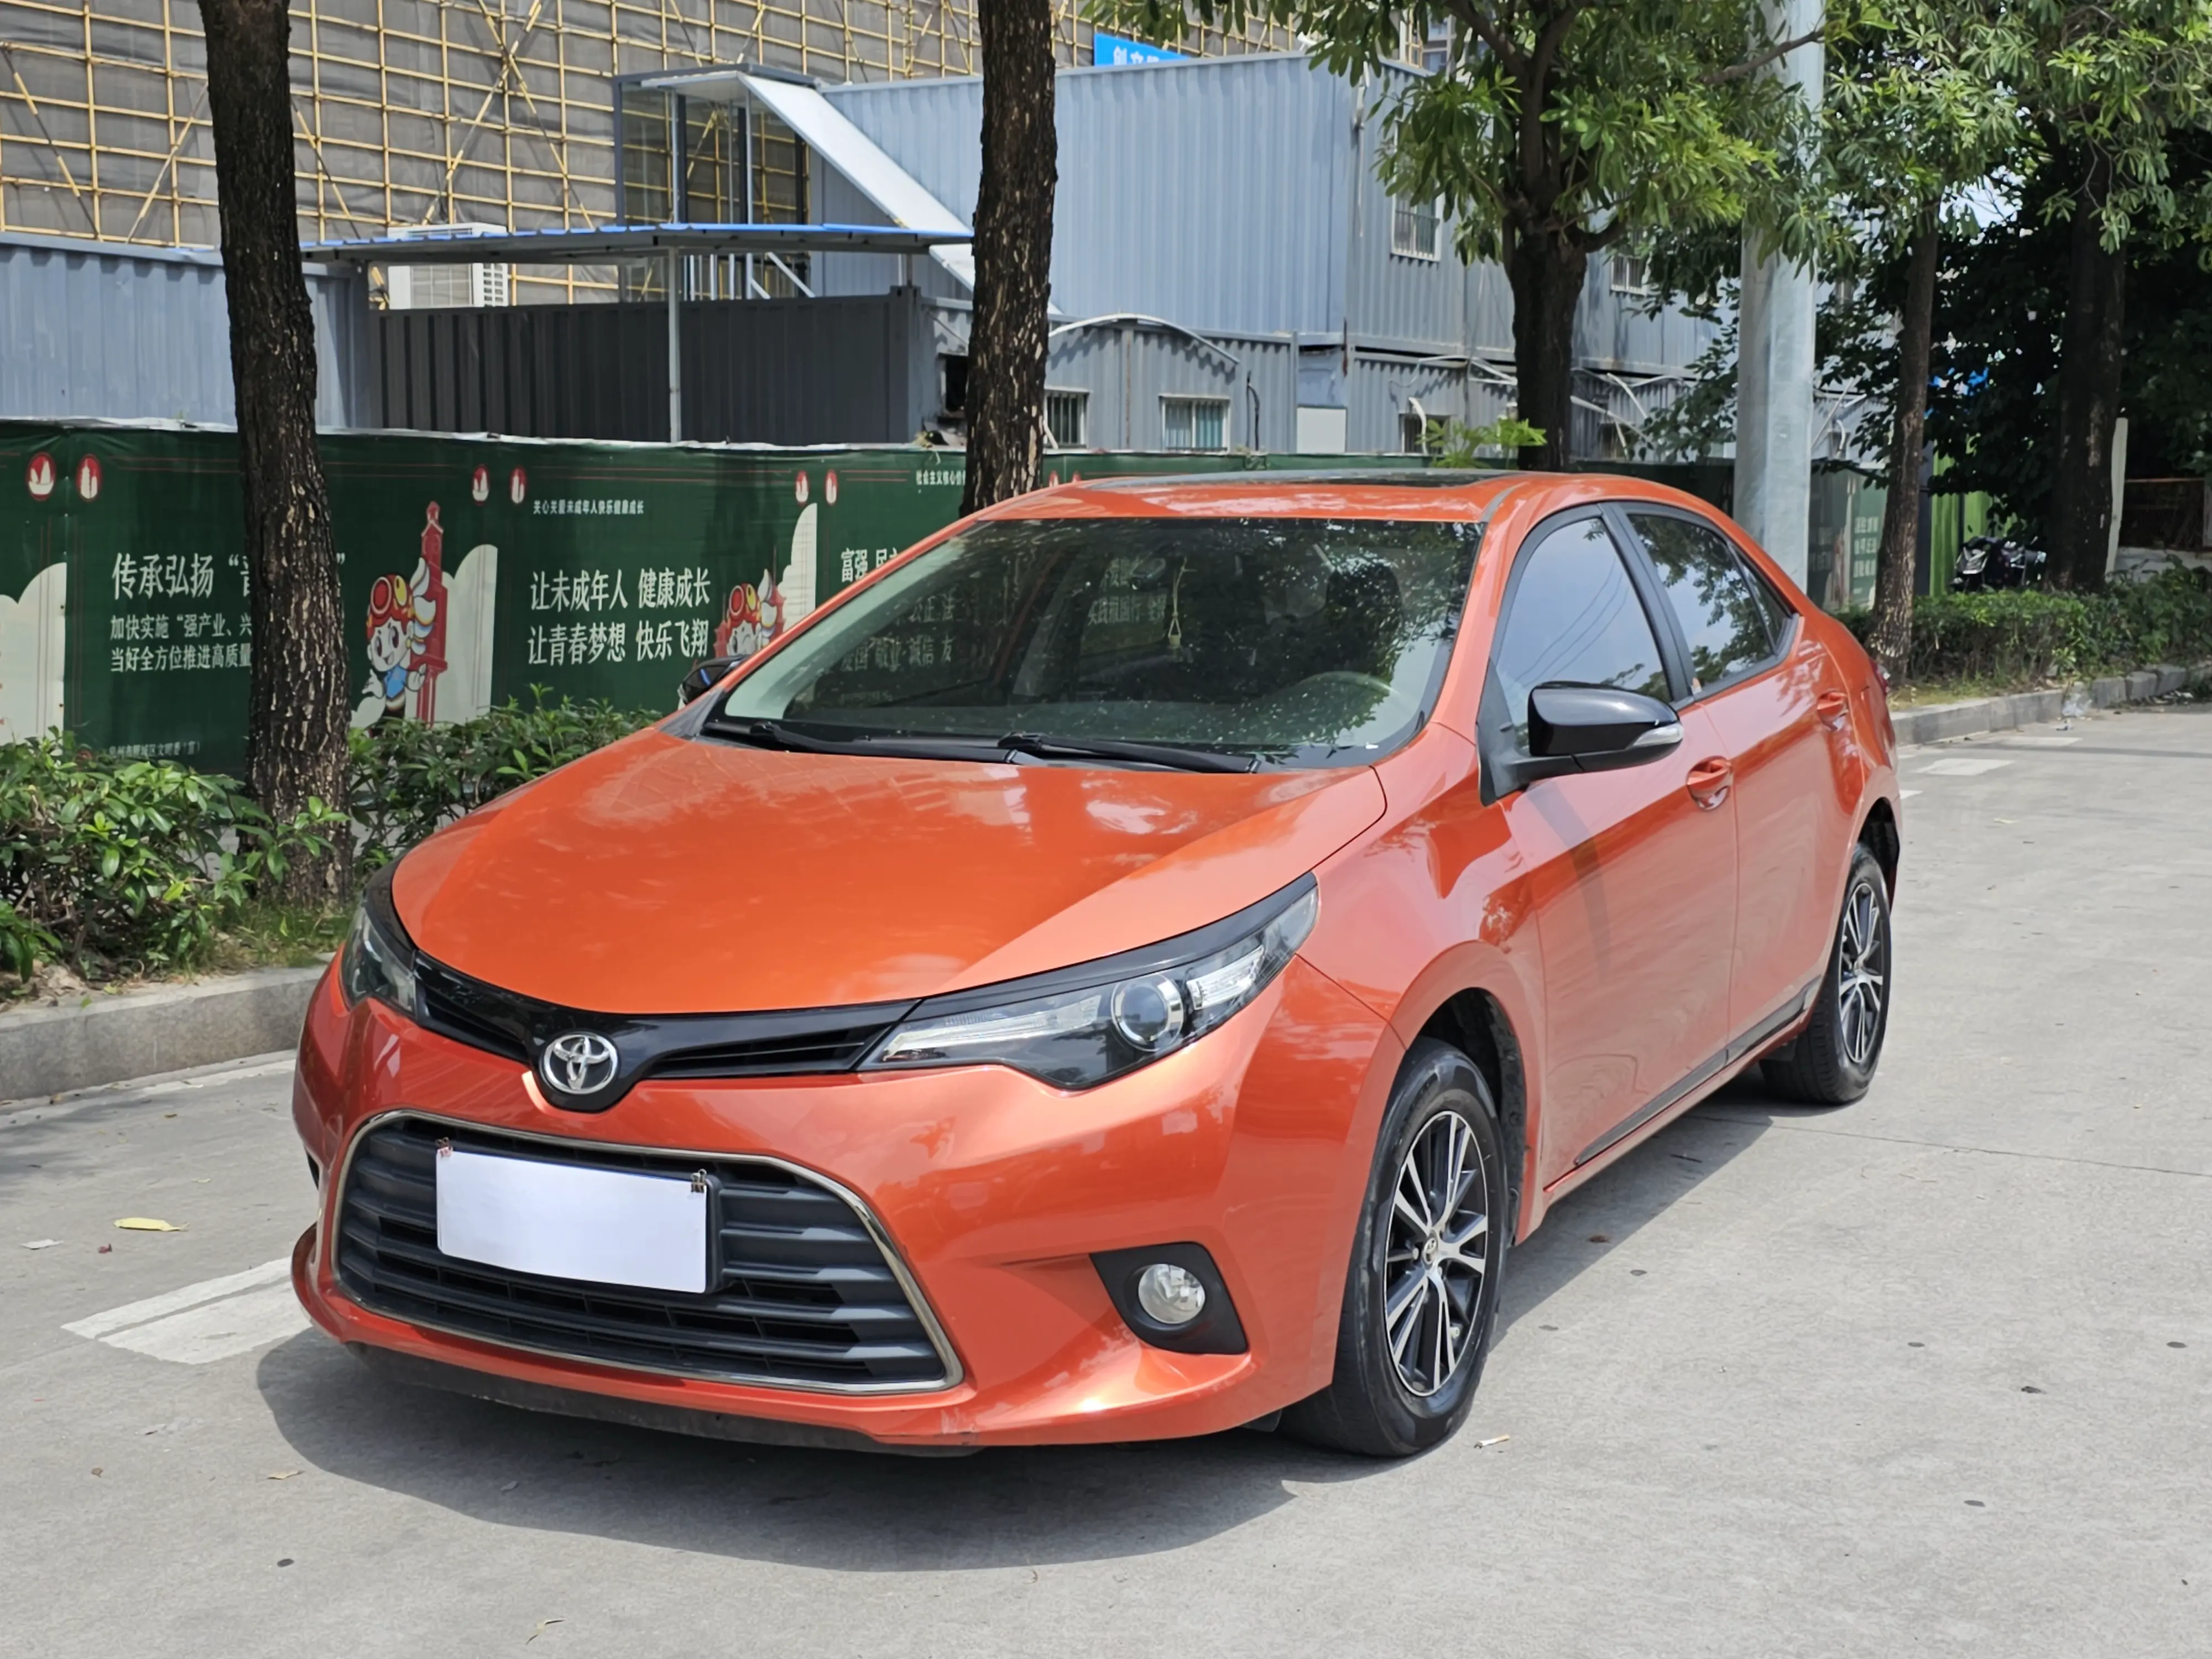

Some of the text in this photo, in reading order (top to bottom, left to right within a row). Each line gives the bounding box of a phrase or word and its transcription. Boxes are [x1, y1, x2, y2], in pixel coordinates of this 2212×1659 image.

[841, 547, 868, 582] 富强
[530, 567, 711, 613] 让未成年人 健康成长
[111, 642, 252, 672] 当好全方位推进高质量
[528, 618, 709, 666] 让青春梦想 快乐飞翔
